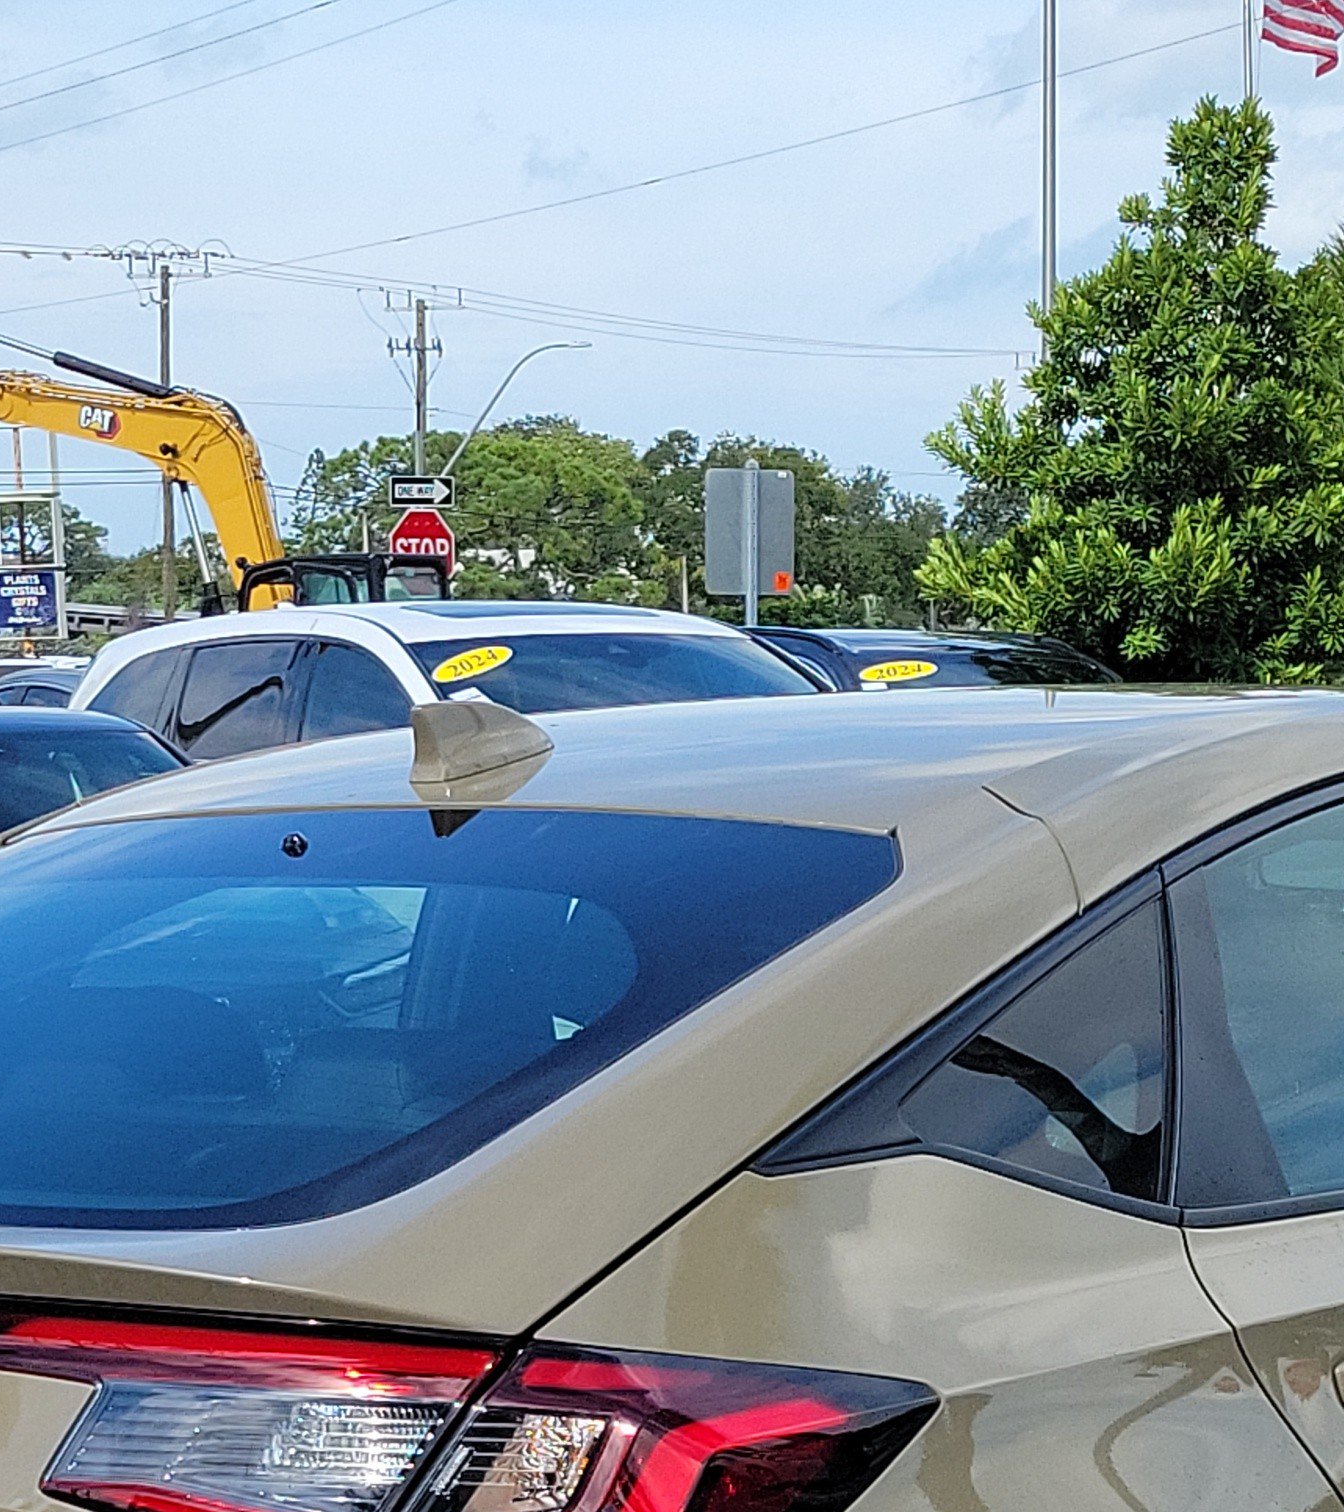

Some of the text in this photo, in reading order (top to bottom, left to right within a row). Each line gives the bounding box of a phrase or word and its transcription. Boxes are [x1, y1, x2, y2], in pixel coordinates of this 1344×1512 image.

[80, 405, 114, 432] CAT
[398, 486, 414, 496] ONE
[396, 537, 450, 555] STOP
[446, 650, 497, 677] 2024
[875, 664, 922, 679] 2024
